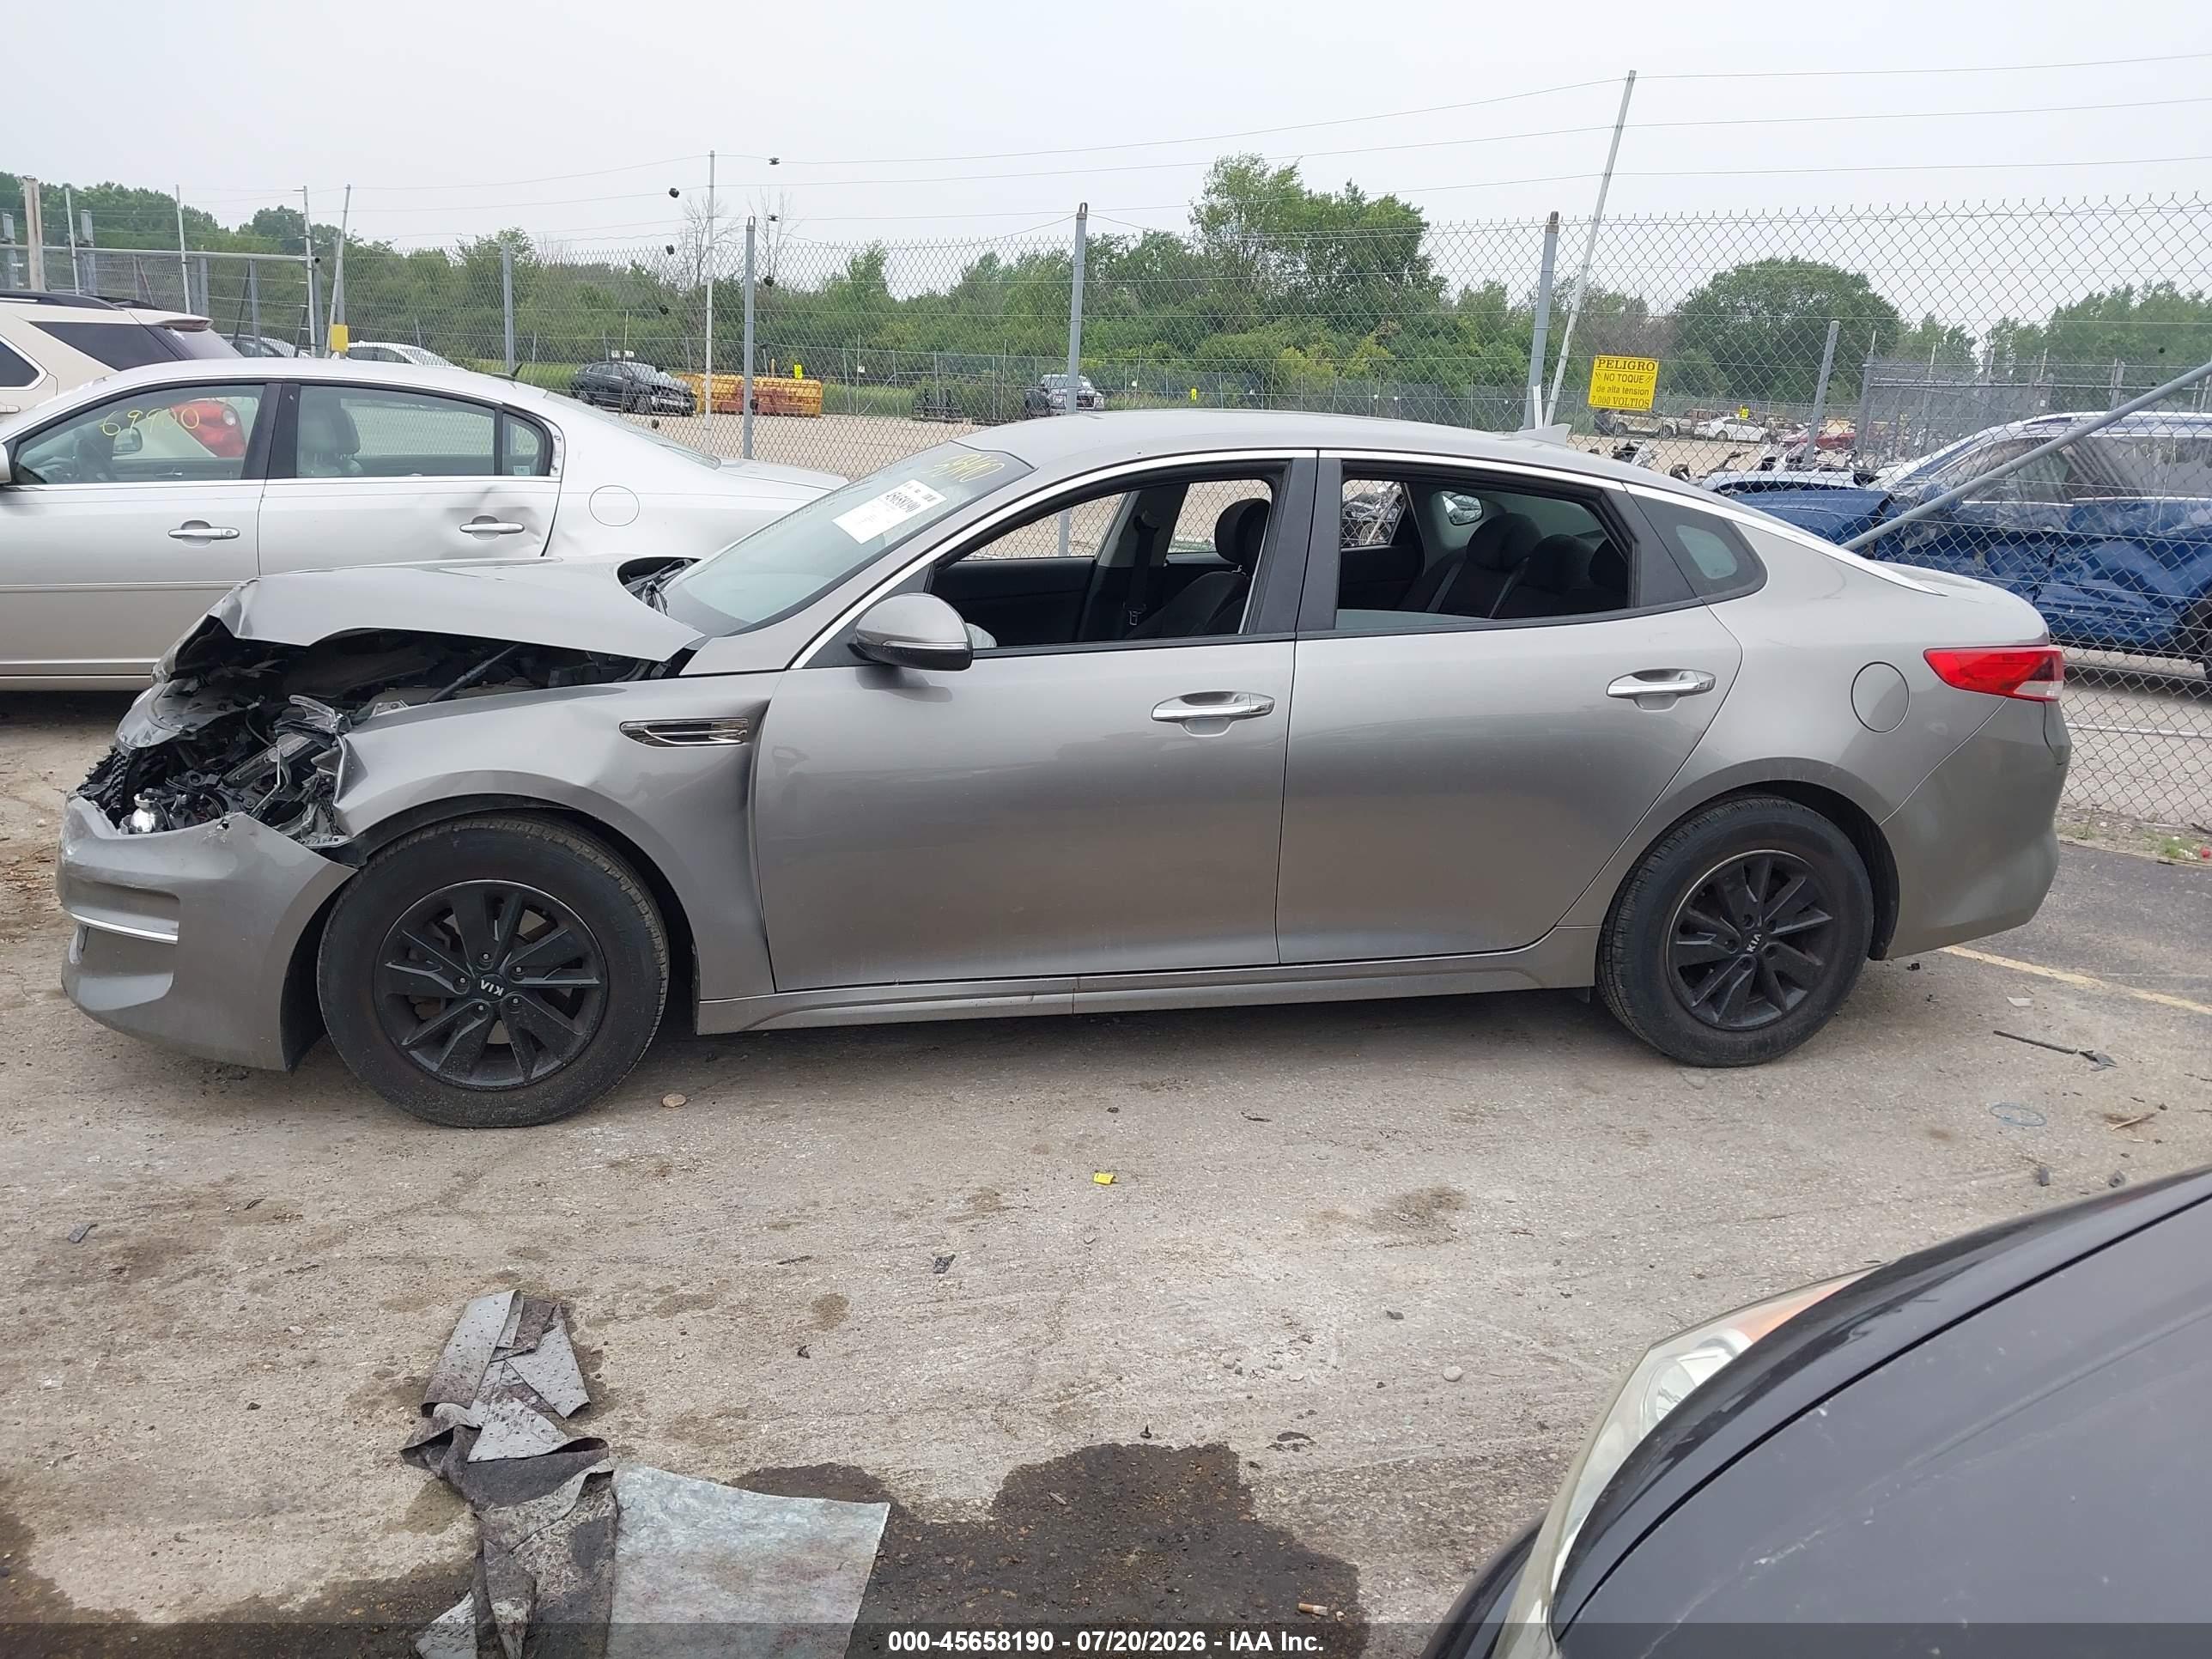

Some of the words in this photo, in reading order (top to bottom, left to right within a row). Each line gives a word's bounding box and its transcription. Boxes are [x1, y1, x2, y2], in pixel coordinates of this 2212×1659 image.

[1597, 359, 1656, 371] PELIGRO
[1604, 373, 1615, 382] NO
[1617, 374, 1644, 384] TOQUE
[1622, 386, 1650, 396] tension
[1612, 397, 1650, 408] VOLTIOS
[1746, 933, 1762, 952] KIA
[480, 979, 505, 996] KIA
